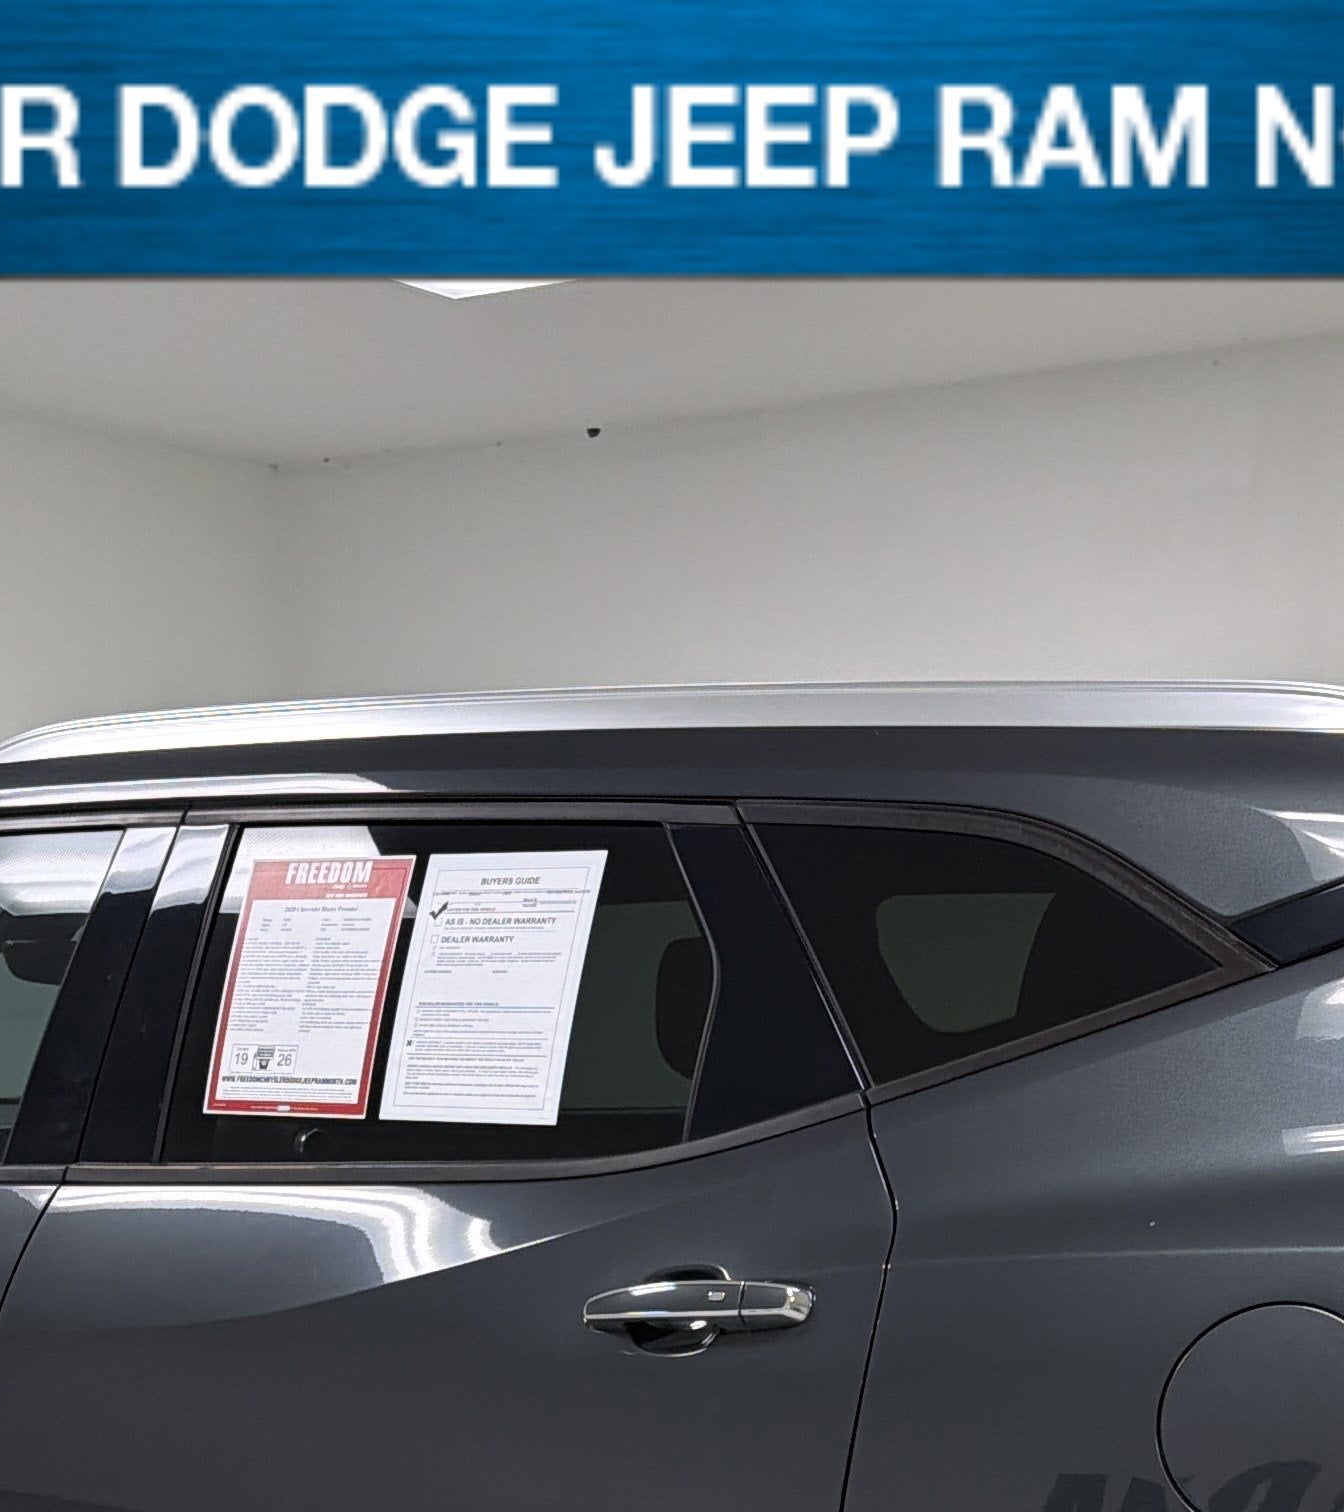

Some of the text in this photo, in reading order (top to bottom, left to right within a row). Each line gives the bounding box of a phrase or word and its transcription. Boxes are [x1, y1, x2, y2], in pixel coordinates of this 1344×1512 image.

[285, 860, 375, 885] FREEDOM
[480, 876, 541, 886] BUYERS GUIDE
[445, 918, 455, 926] AS
[469, 917, 481, 925] NO
[483, 917, 512, 925] DEALER
[513, 917, 557, 925] WARRANTY
[441, 935, 515, 944] DEALER WARRANTY
[234, 1052, 249, 1066] 19
[277, 1053, 292, 1067] 26
